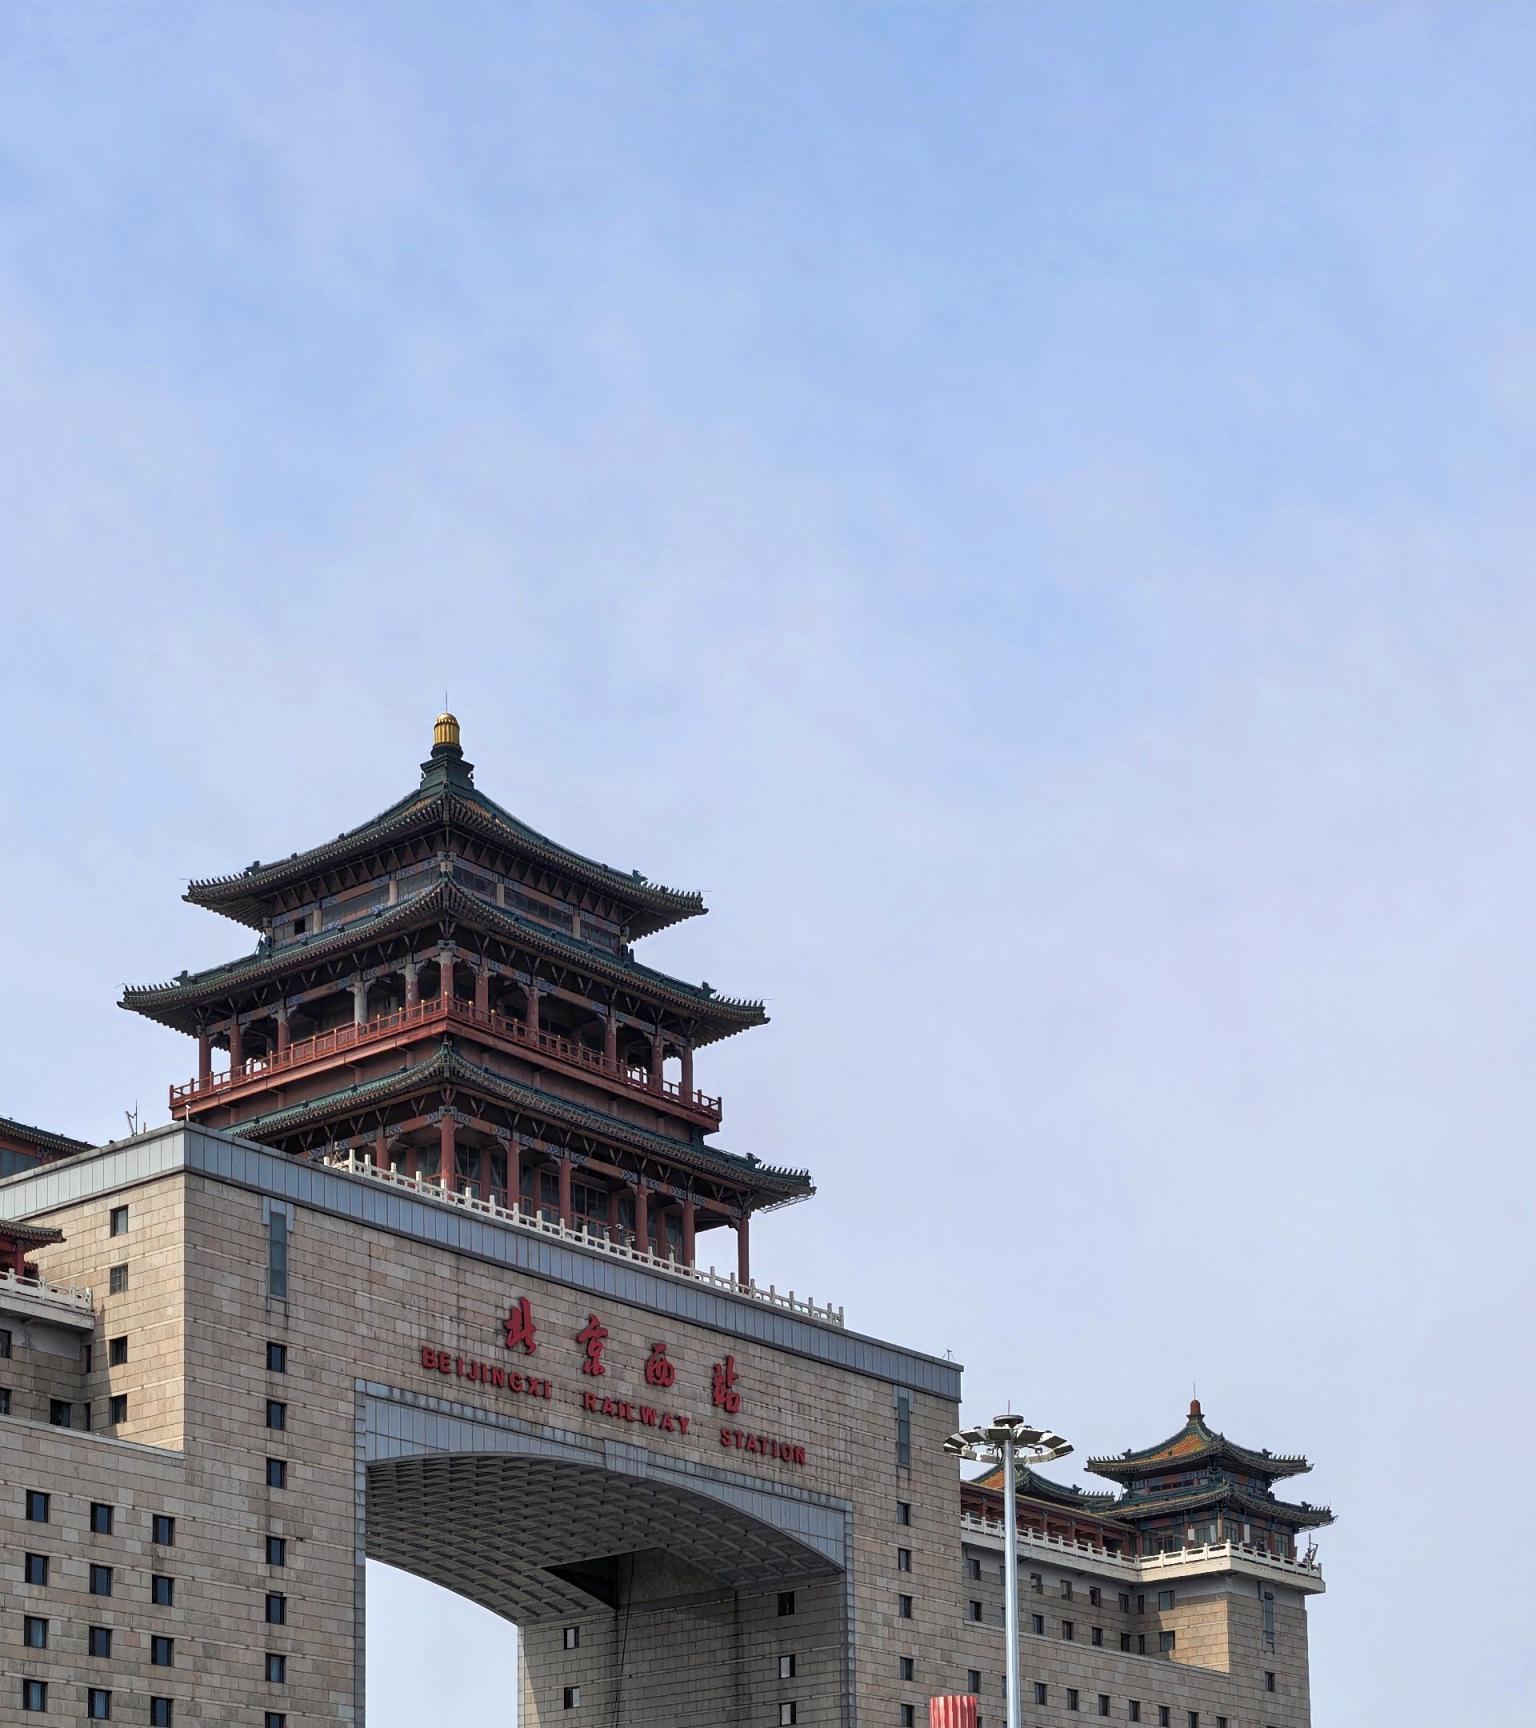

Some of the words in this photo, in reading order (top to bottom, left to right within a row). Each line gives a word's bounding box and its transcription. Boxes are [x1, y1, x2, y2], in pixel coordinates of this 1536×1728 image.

[421, 1346, 553, 1401] BEIJINGXI
[583, 1391, 690, 1436] RAILWAY
[719, 1426, 806, 1466] STATION
[503, 1296, 741, 1414] 北京西站
